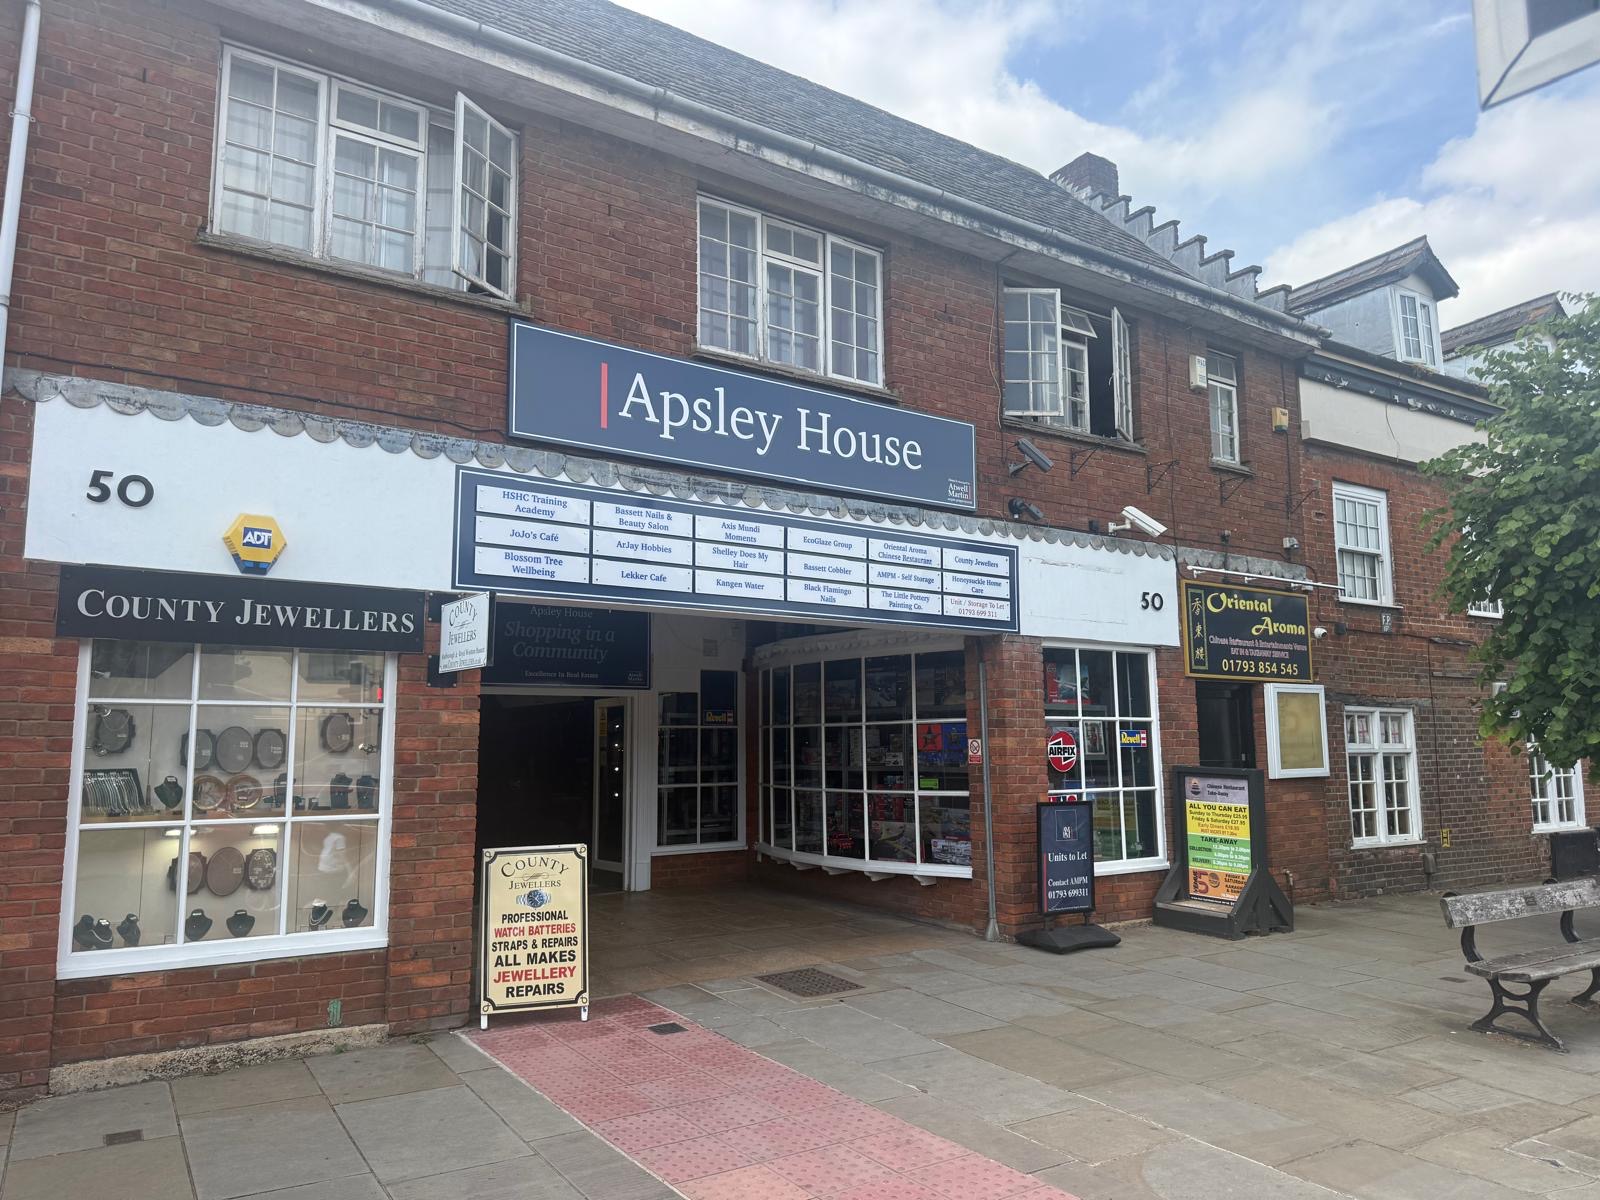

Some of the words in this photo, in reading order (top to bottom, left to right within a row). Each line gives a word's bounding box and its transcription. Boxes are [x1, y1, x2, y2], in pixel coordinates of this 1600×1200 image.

[619, 372, 782, 455] Apsley
[797, 407, 922, 469] House
[86, 470, 154, 507] 50
[949, 490, 968, 499] Martin
[502, 491, 529, 502] HSHC
[532, 494, 568, 508] Training
[515, 504, 555, 518] Academy
[615, 507, 643, 518] Bassett
[645, 510, 664, 520] Nails
[666, 512, 673, 520] &
[619, 518, 645, 530] Beauty
[648, 521, 669, 531] Salon
[721, 522, 736, 531] Axis
[738, 524, 760, 533] Mundi
[243, 531, 272, 546] ADT
[510, 529, 537, 540] JoJo's
[540, 531, 559, 542] Café
[725, 533, 757, 543] Moments
[616, 541, 638, 552] ArJay
[641, 543, 672, 553] Hobbies
[803, 536, 831, 546] EcoGlaze
[834, 540, 852, 550] Group
[884, 543, 907, 552] Oriental
[909, 546, 927, 554] Aroma
[504, 552, 542, 564] Blossom
[544, 556, 563, 566] Tree
[712, 547, 737, 558] Shelley
[740, 549, 756, 558] Does
[758, 552, 769, 562] My
[878, 552, 901, 560] Chinese
[903, 555, 932, 565] Restaurant
[733, 561, 748, 569] Hair
[954, 556, 974, 566] County
[975, 559, 998, 568] Jewellers
[512, 565, 555, 578] Wellbeing
[804, 563, 826, 572] Bassett
[828, 566, 852, 575] Cobbler
[621, 570, 647, 581] Lekker
[650, 573, 667, 582] Cafe
[877, 571, 896, 579] AMPM
[914, 575, 934, 584] Storage
[952, 576, 985, 586] Honeysuckle
[716, 579, 742, 589] Kangen
[745, 581, 764, 590] Water
[804, 584, 821, 592] Black
[823, 586, 852, 595] Flamingo
[820, 594, 836, 603] Nails
[910, 593, 930, 602] Pottery
[1141, 591, 1164, 611] 50
[1207, 592, 1273, 613] Oriental
[77, 589, 225, 623] COUNTY
[235, 598, 415, 634] JEWELLERS
[889, 601, 912, 610] Painting
[968, 601, 988, 609] Storage
[449, 600, 477, 626] COUNTY
[530, 606, 561, 618] Apsley
[565, 607, 592, 618] House
[504, 620, 581, 644] Shopping
[586, 625, 601, 642] in
[605, 629, 615, 643] a
[1251, 616, 1306, 636] Aroma
[513, 642, 608, 664] Community
[1222, 659, 1255, 673] 01793
[1259, 662, 1278, 674] 854
[1281, 663, 1298, 675] 545
[1121, 732, 1140, 744] Revell
[1049, 746, 1076, 756] AIRFIX
[1192, 815, 1205, 823] Friday
[1200, 836, 1238, 845] TAKE-AWAY
[1048, 852, 1067, 862] Units
[1069, 853, 1076, 861] to
[1077, 851, 1087, 860] Let
[501, 856, 570, 878] COUNTY
[509, 879, 561, 890] JEWELLERS
[1048, 878, 1069, 887] Contact
[1070, 876, 1088, 885] AMPM
[1048, 890, 1067, 899] 01793
[1068, 888, 1088, 897] 699311
[502, 910, 568, 924] PROFESSIONAL
[494, 926, 525, 938] WATCH
[528, 923, 576, 936] BATTERIES
[492, 939, 528, 953] STRAPS
[531, 939, 538, 949] &
[542, 936, 578, 948] REPAIRS
[494, 954, 521, 968] ALL
[527, 949, 576, 965] MAKES
[493, 966, 577, 983] JEWELLERY
[506, 982, 564, 998] REPAIRS
